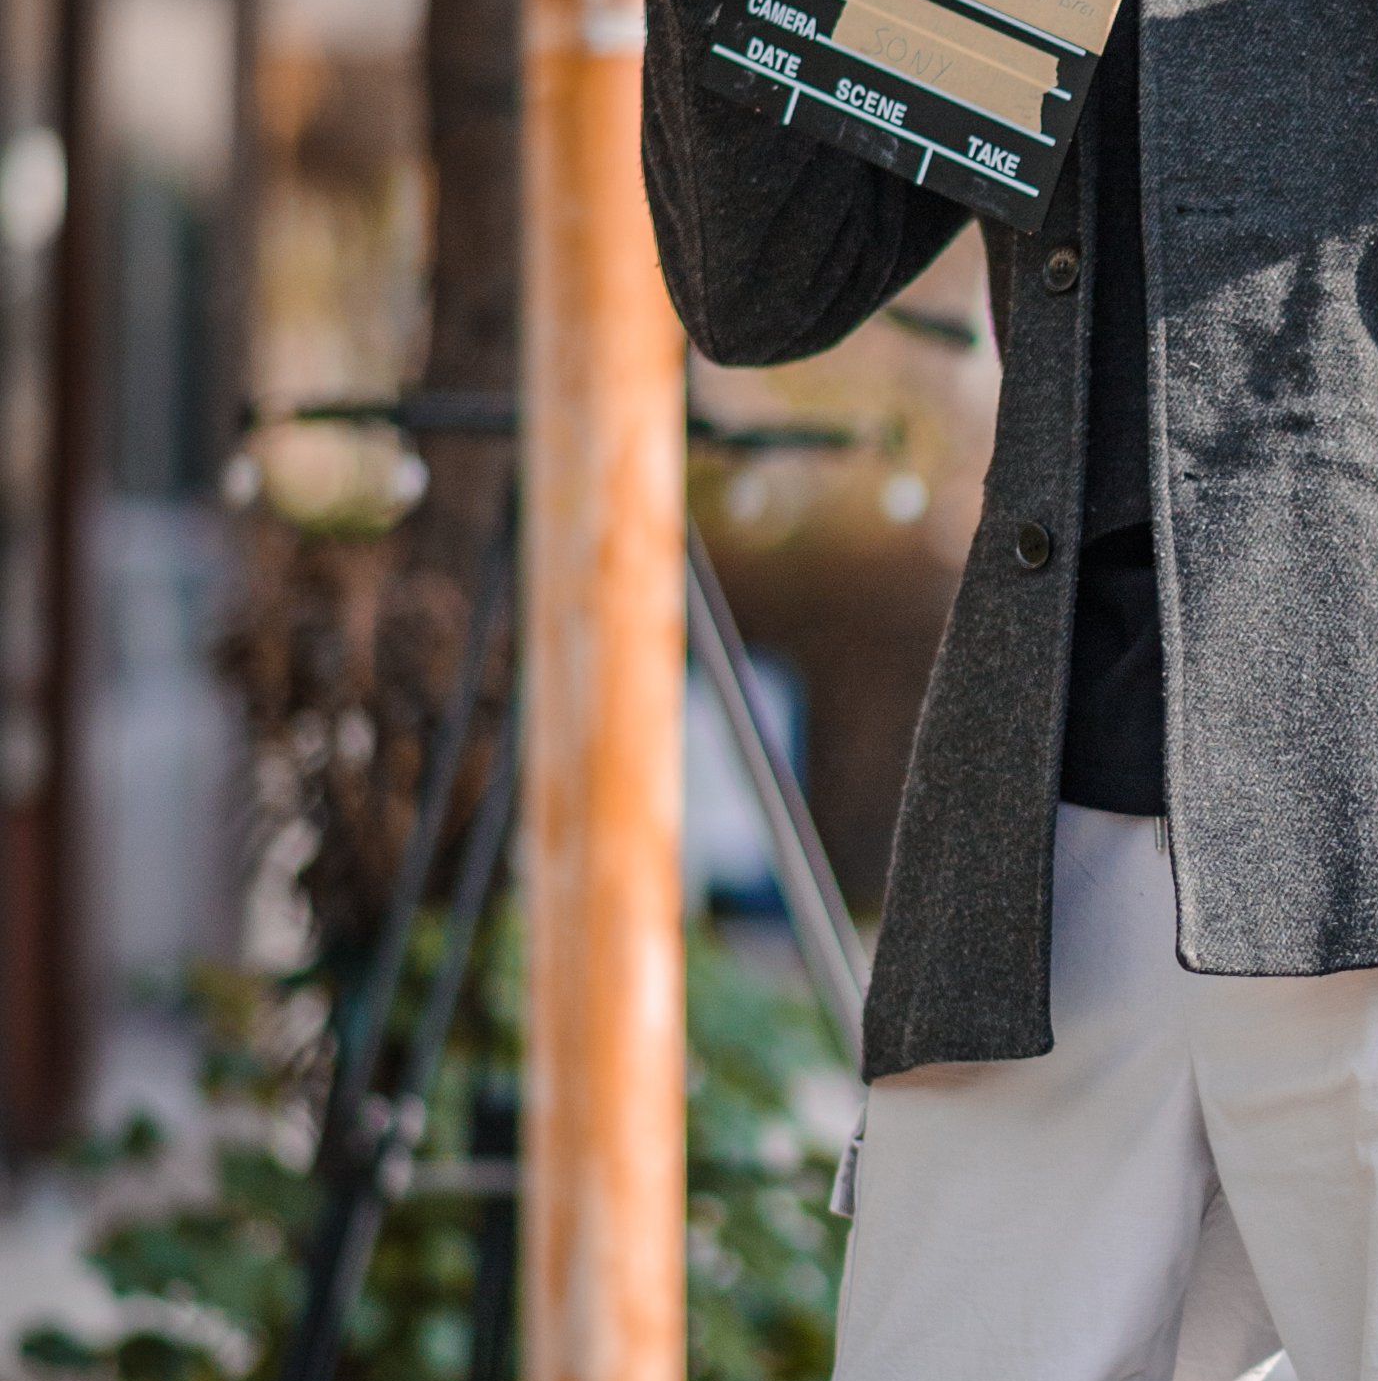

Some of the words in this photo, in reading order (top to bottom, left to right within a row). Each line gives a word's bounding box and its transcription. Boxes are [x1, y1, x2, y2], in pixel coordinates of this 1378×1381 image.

[868, 26, 953, 84] SONY
[746, 37, 802, 79] DATE
[836, 78, 907, 126] SCENE
[967, 135, 1020, 178] TAKE
